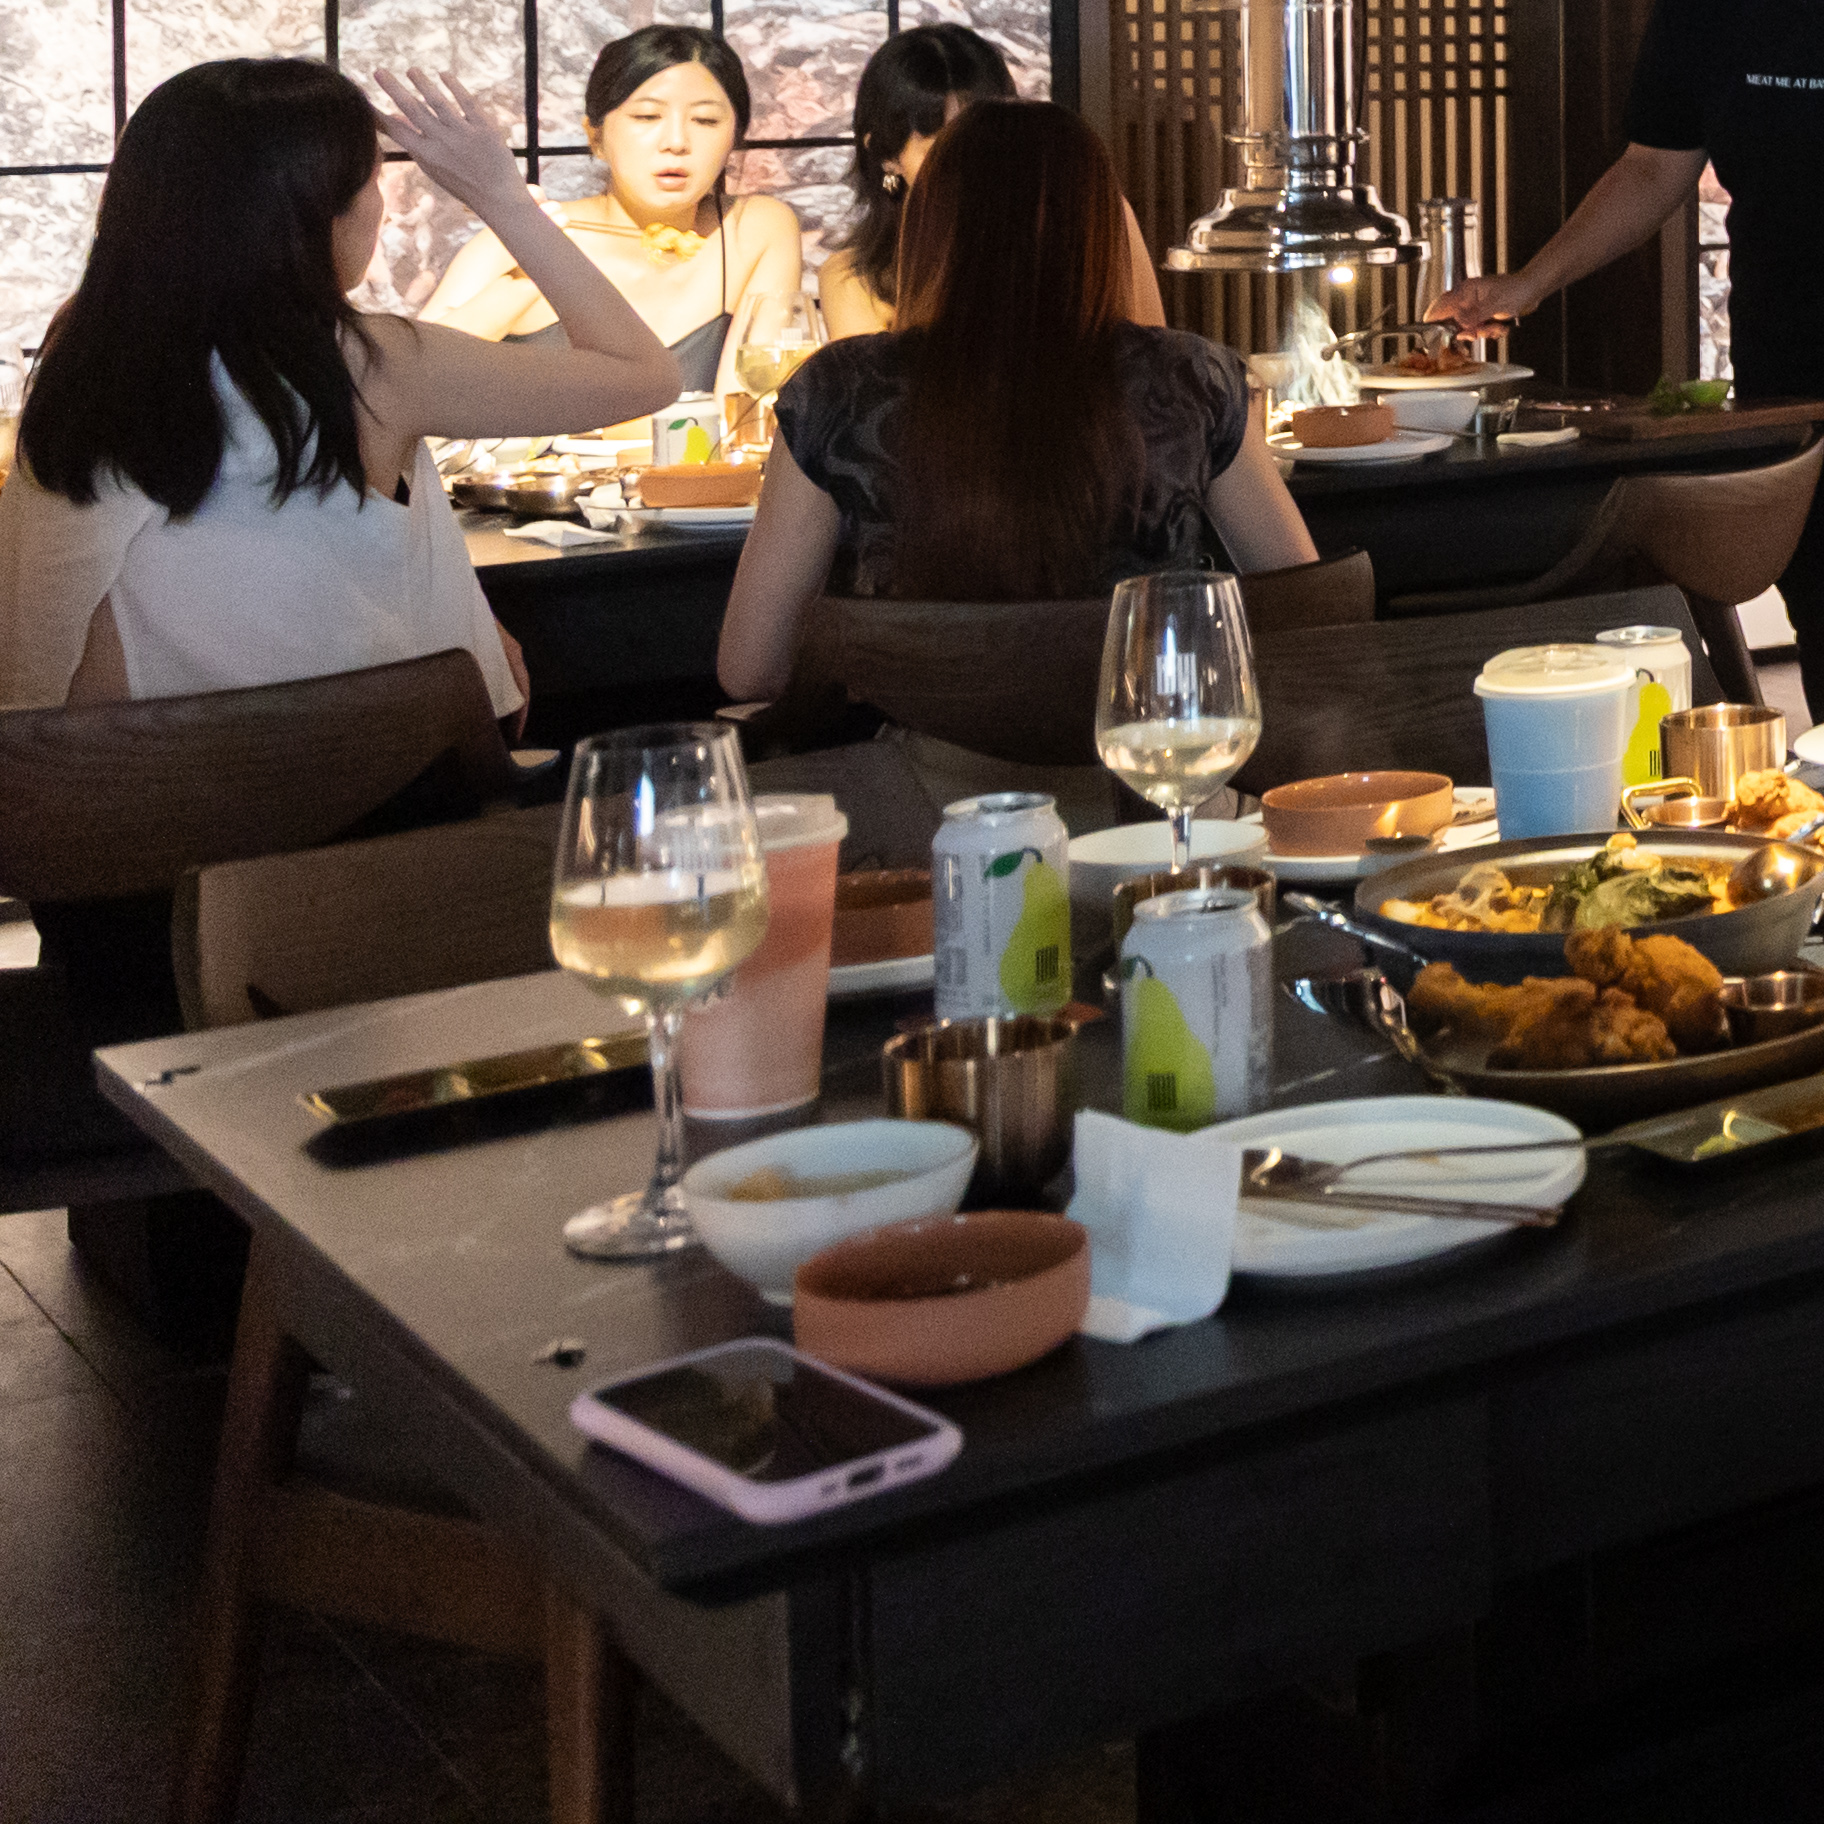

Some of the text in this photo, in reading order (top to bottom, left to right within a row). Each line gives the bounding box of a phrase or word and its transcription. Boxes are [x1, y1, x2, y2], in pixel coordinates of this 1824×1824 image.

[1746, 73, 1773, 86] MEAT
[1775, 76, 1791, 88] ME
[1792, 77, 1807, 89] AT
